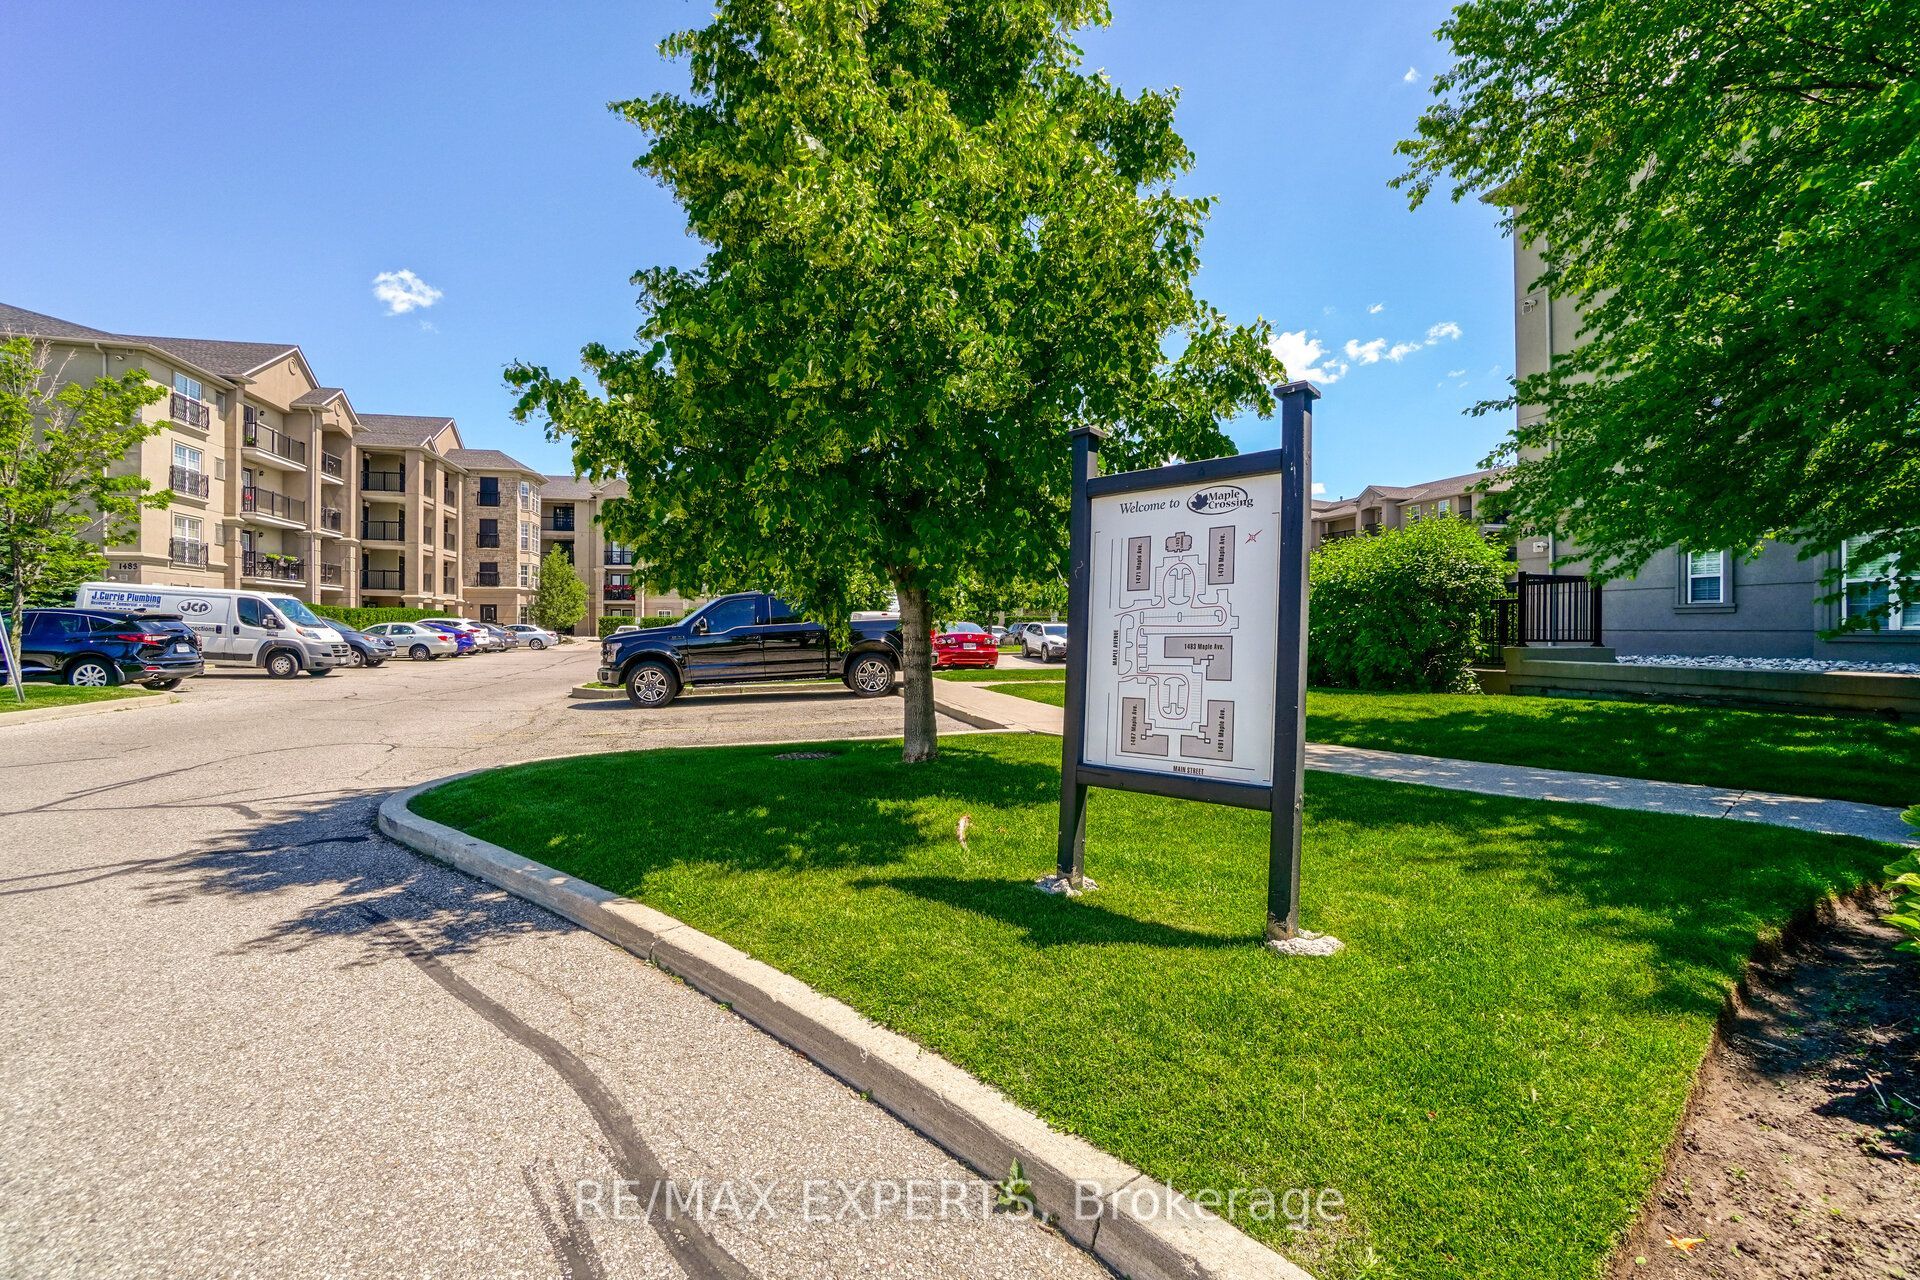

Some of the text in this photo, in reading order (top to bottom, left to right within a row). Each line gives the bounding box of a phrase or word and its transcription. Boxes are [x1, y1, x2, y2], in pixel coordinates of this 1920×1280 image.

[1208, 489, 1240, 502] Maple
[1120, 499, 1180, 514] Welcome to
[1208, 498, 1254, 510] Crossing
[118, 562, 138, 570] 1483
[126, 593, 162, 605] Plumbing
[181, 602, 209, 613] JCP
[1197, 643, 1213, 651] Maple
[1173, 765, 1205, 775] MAIN STREET
